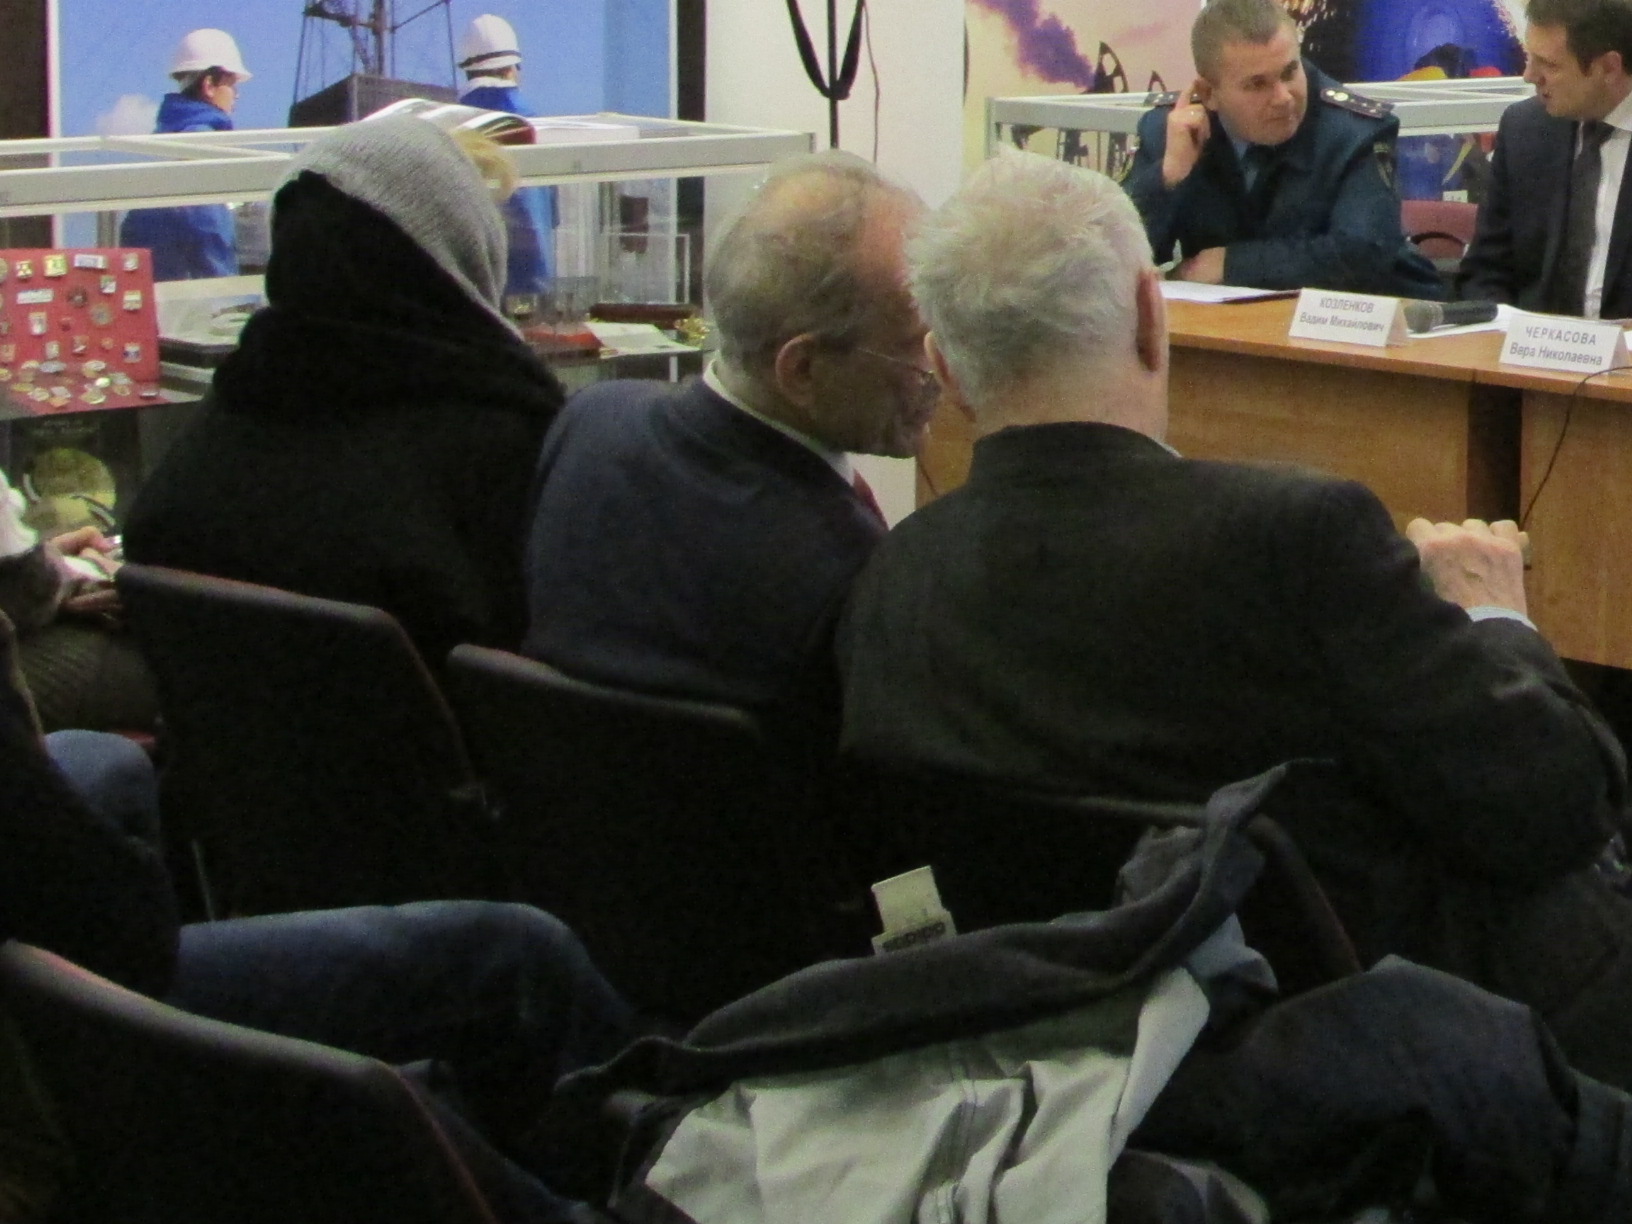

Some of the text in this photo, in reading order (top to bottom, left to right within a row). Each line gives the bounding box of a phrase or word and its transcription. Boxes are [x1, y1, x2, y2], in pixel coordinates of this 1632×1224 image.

[1320, 297, 1375, 313] КОЗЛЕНКОВ
[1300, 312, 1328, 325] Вадим
[1526, 326, 1596, 345] ЧЕРКАСОВА
[1510, 342, 1603, 366] Вера Николаевна
